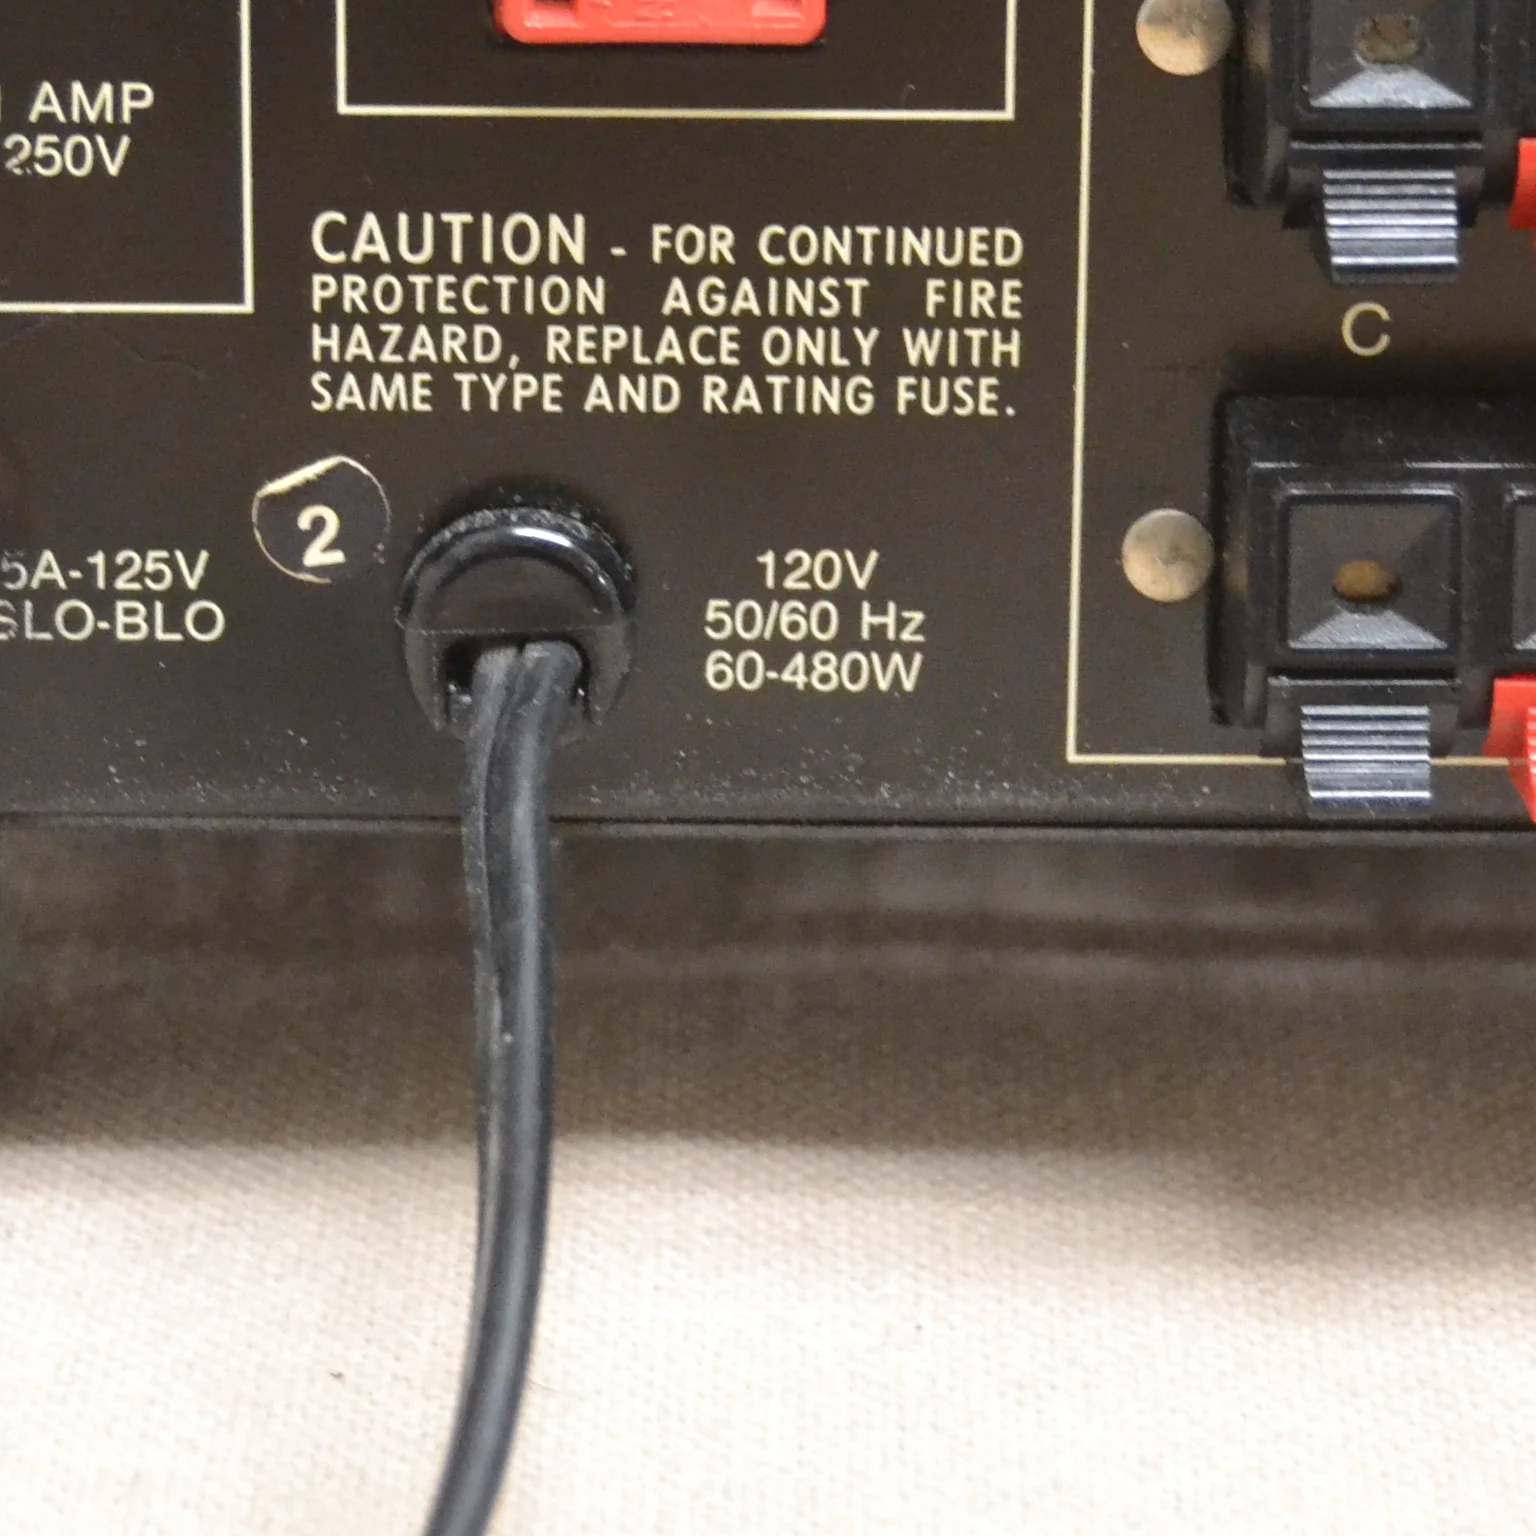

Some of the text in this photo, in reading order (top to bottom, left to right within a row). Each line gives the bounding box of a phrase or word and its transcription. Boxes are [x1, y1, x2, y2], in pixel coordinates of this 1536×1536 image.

[29, 81, 153, 123] AMP
[4, 134, 130, 176] 250V
[312, 211, 584, 265] CAUTION
[653, 224, 735, 264] FOR
[759, 225, 1023, 266] CONTINUED
[312, 274, 1022, 318] PROTECTION AGAINST FIRE
[312, 324, 1020, 369] HAZARD, REPLACE ONLY WITH
[1342, 301, 1390, 356] C
[311, 372, 1014, 416] SAME TYPE AND RATING FUSE.
[298, 505, 345, 567] 2
[3, 550, 209, 591] 5A-125V
[757, 549, 878, 590] 120V
[705, 600, 924, 641] 50/60 Hz
[705, 650, 922, 692] 60-480W
